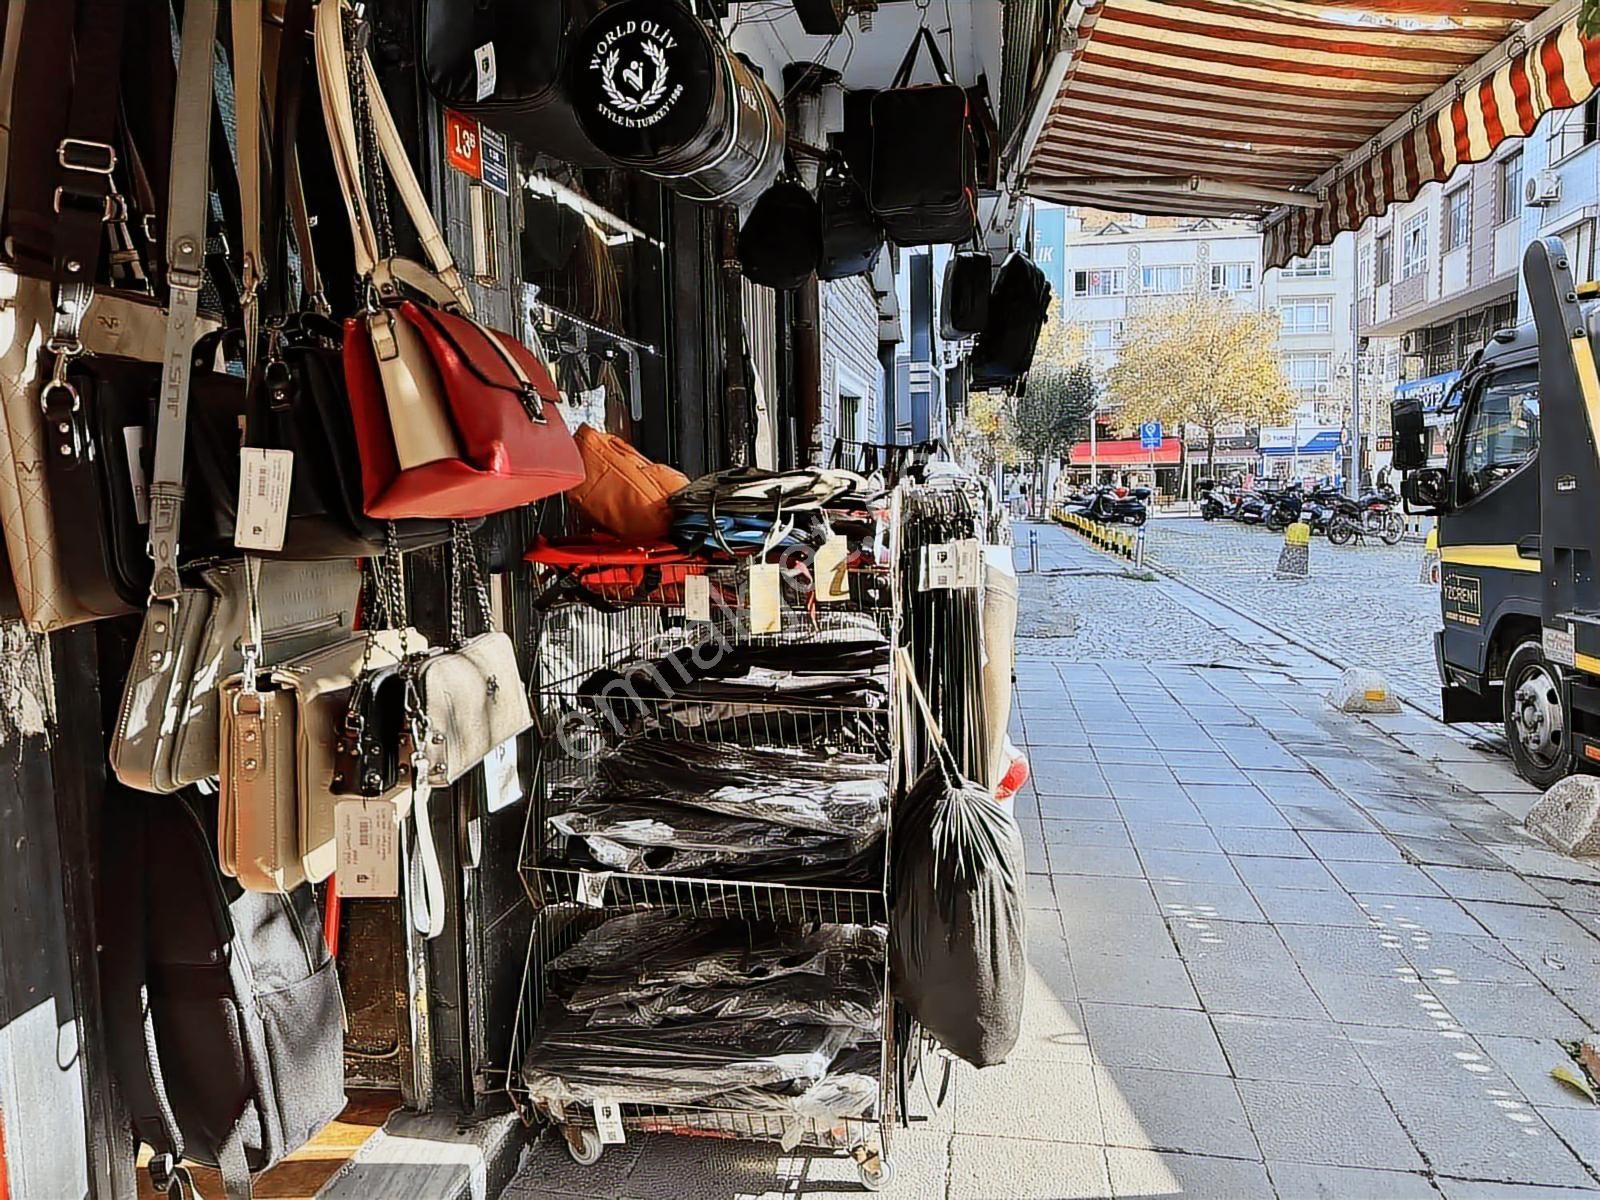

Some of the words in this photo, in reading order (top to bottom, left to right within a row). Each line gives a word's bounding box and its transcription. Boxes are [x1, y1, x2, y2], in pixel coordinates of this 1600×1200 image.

[589, 20, 637, 70] WORLD
[597, 103, 625, 126] STYLE
[636, 101, 670, 129] TURKEY
